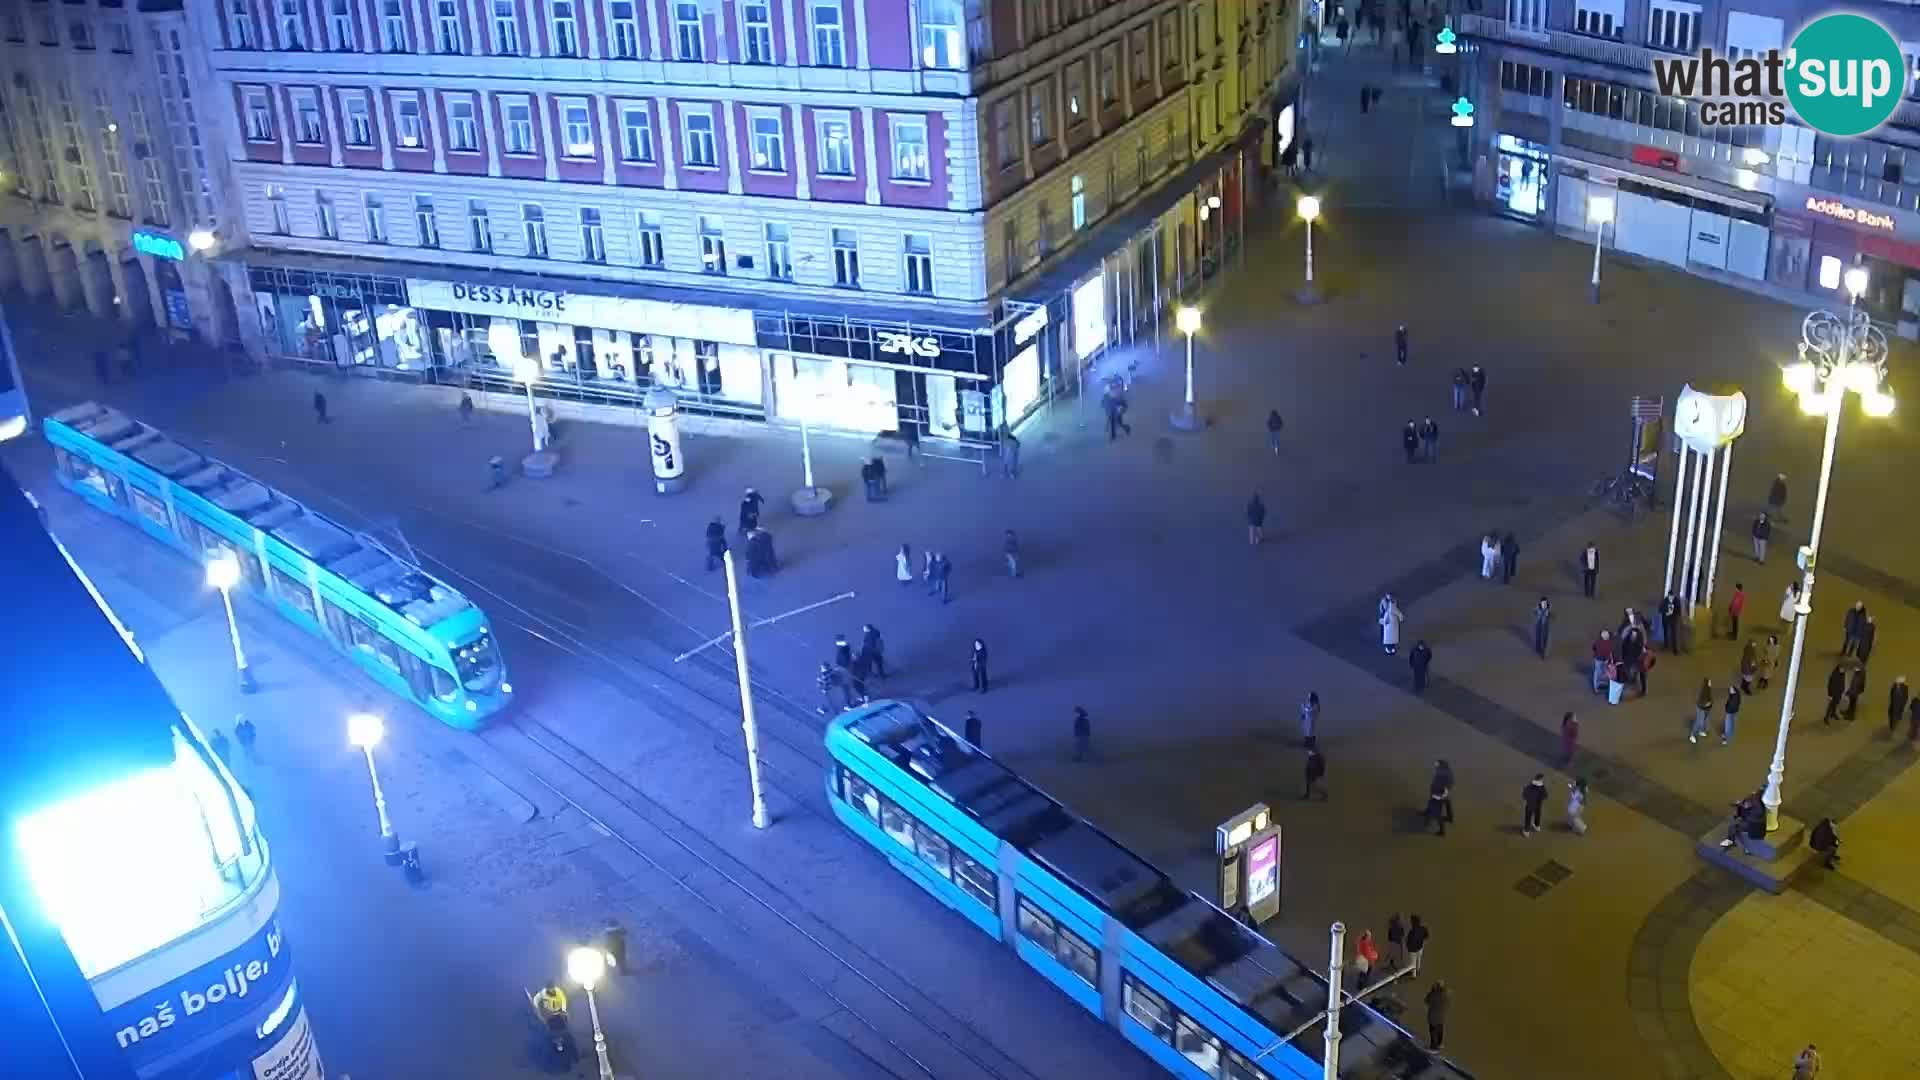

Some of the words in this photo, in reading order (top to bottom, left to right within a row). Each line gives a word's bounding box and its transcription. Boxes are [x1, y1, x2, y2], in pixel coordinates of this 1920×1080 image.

[1806, 197, 1856, 220] Addiko
[1856, 209, 1896, 230] Bank
[453, 283, 566, 311] DESSANGE
[115, 999, 177, 1048] naš
[179, 959, 268, 1016] bolje,
